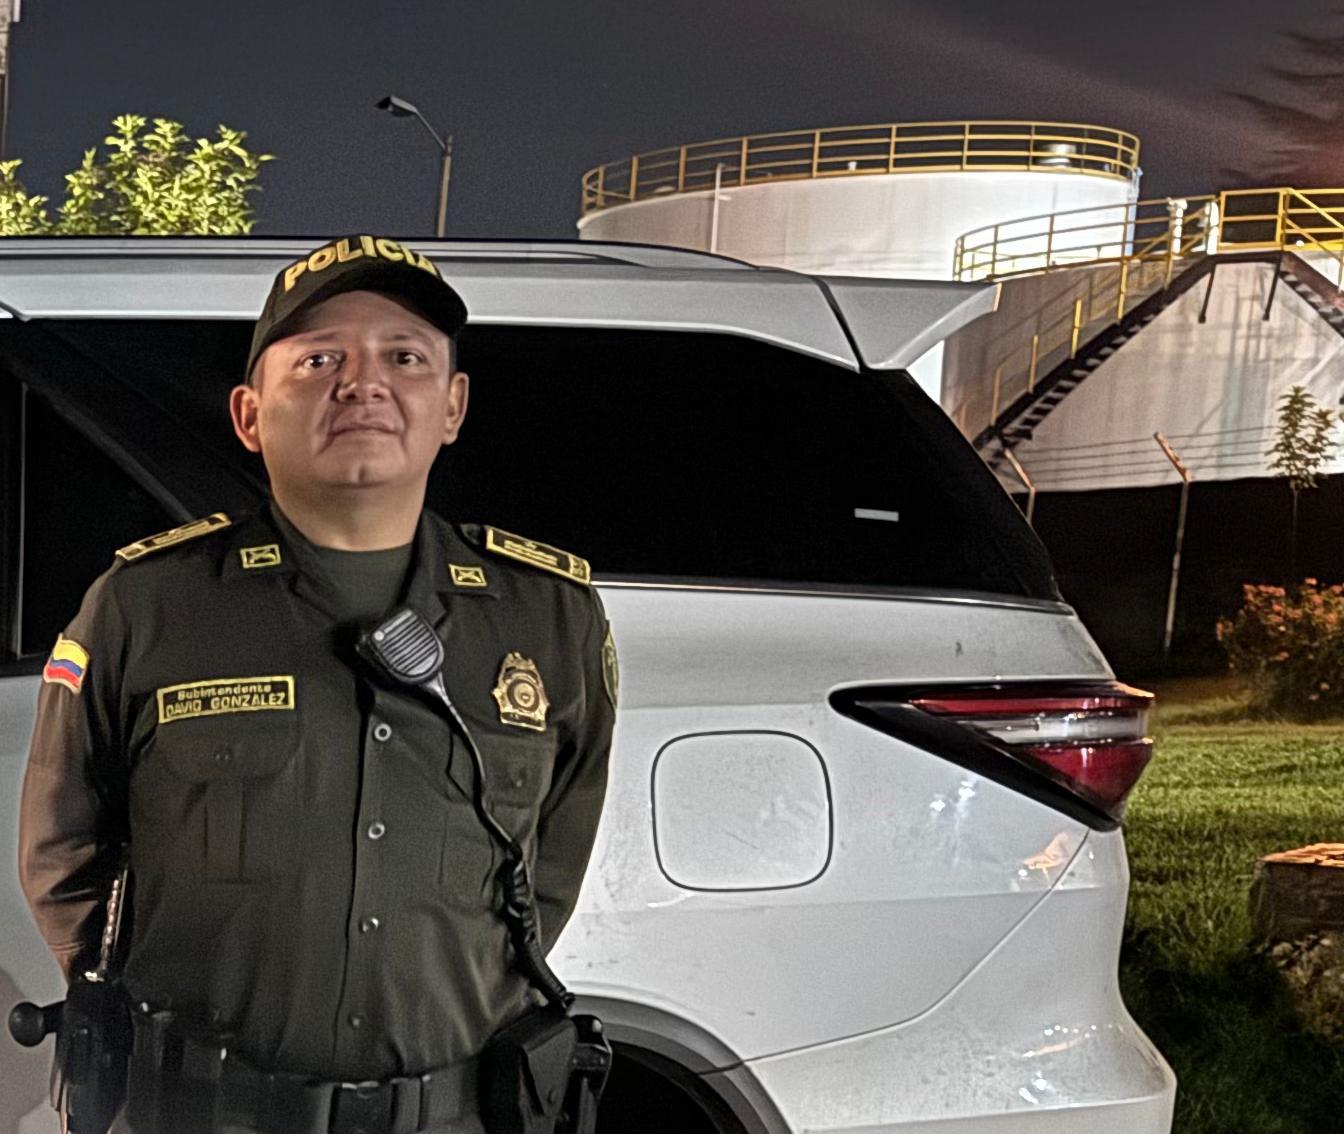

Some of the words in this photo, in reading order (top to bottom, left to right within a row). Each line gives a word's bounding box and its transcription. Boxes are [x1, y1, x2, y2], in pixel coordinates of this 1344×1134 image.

[177, 683, 272, 701] Subintendente
[165, 700, 203, 718] DAVID
[210, 692, 286, 710] GONZALEZ
